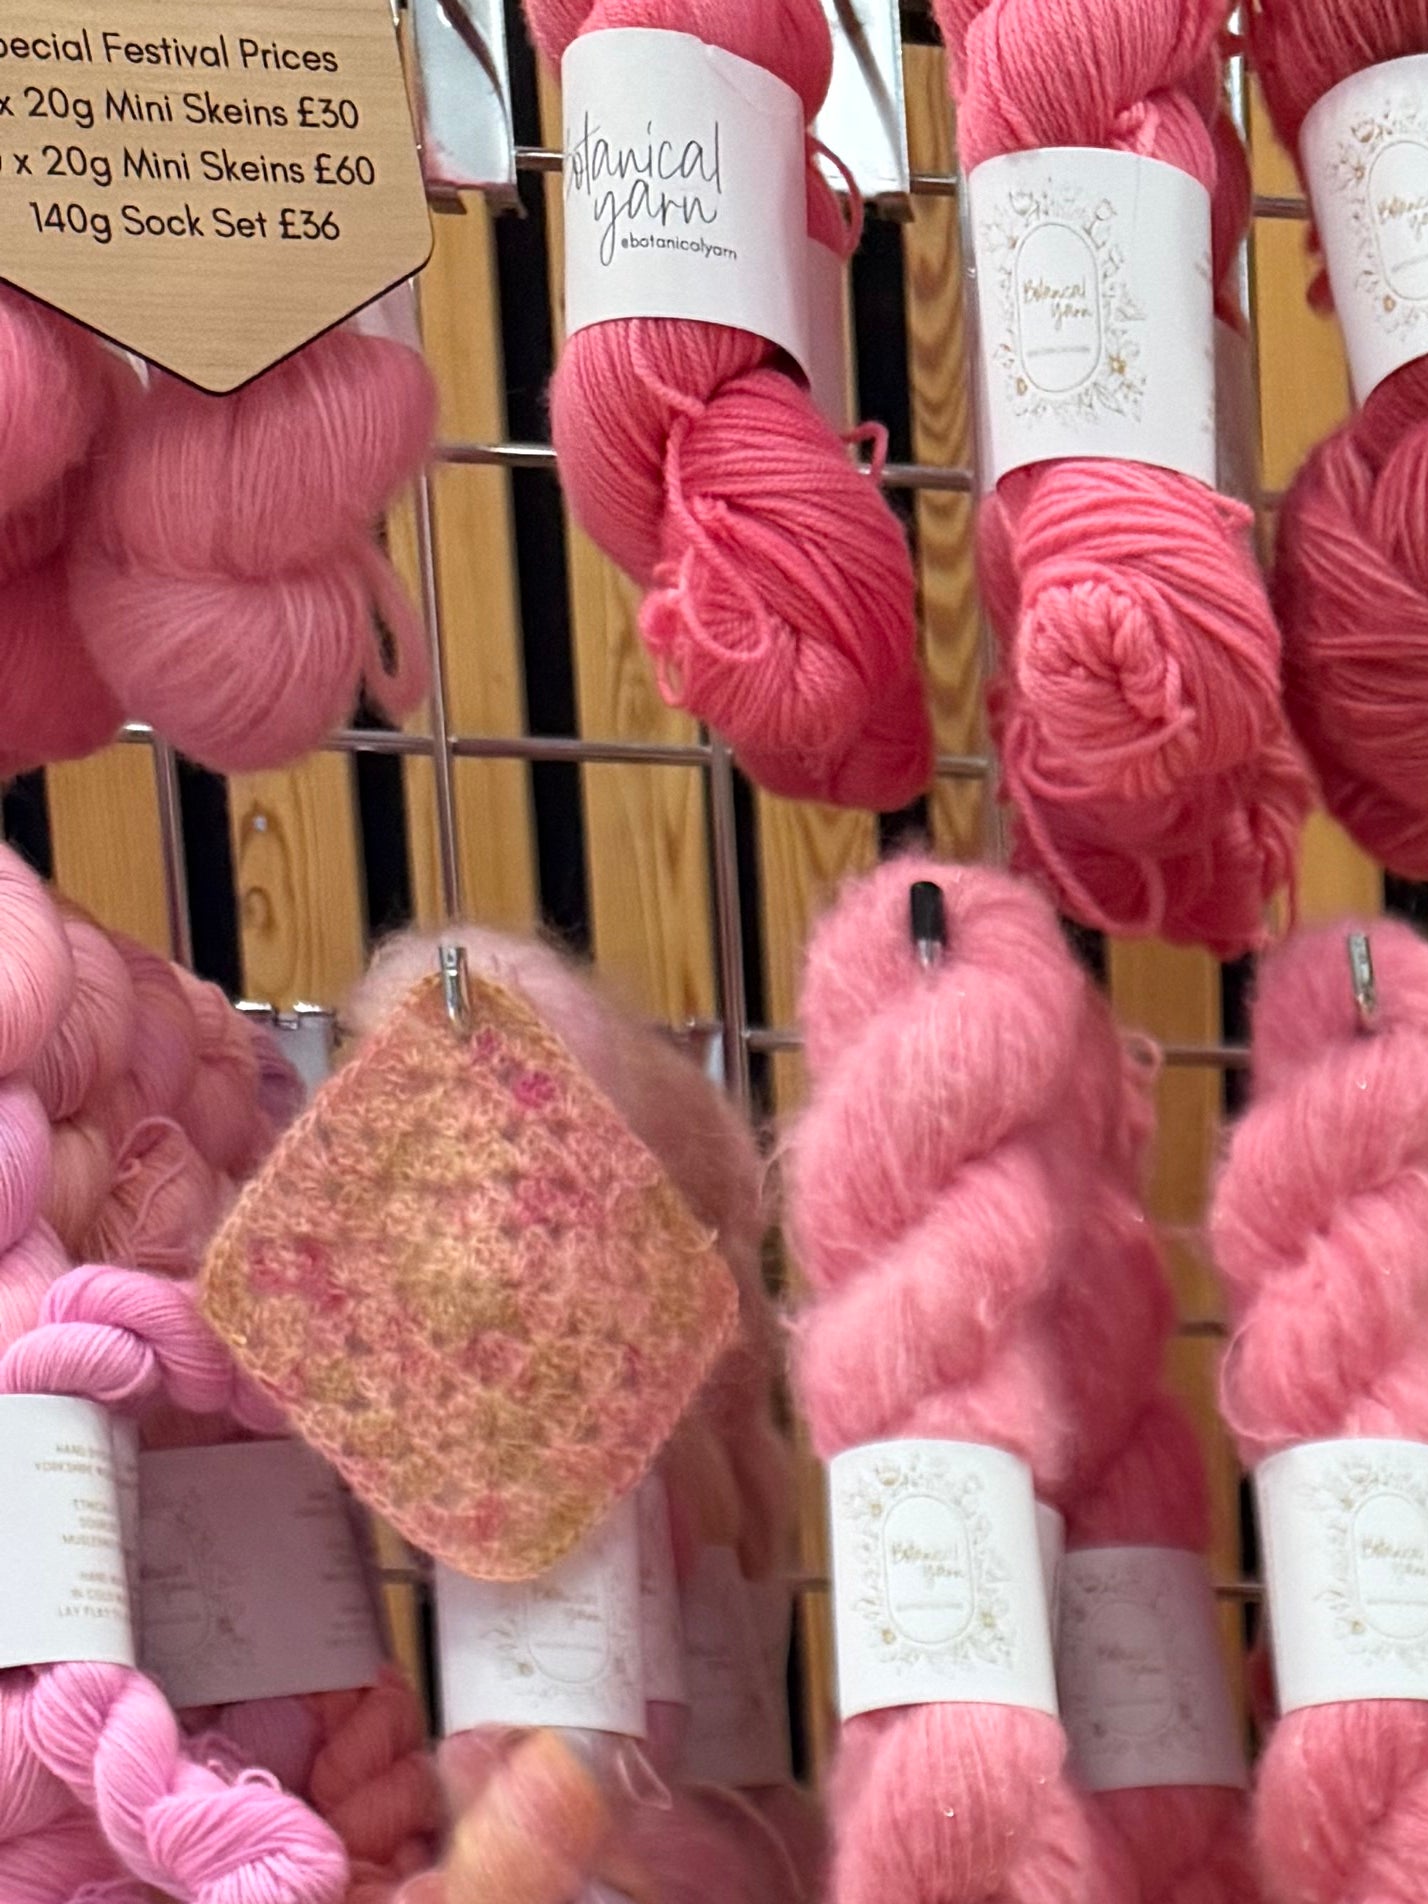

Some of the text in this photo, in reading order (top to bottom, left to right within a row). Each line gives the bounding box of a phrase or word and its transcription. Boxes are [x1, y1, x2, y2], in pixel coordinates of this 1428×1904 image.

[0, 28, 339, 72] ecial Festival Prices
[24, 87, 95, 129] 20g
[106, 89, 173, 122] Mini
[183, 91, 288, 128] Skeins
[298, 96, 359, 129] £30
[13, 153, 33, 175] x
[42, 145, 112, 187] 20g
[123, 146, 190, 181] Mini
[200, 148, 305, 184] Skeins
[314, 152, 375, 186] £60
[29, 201, 341, 244] 140g Sock Set £36
